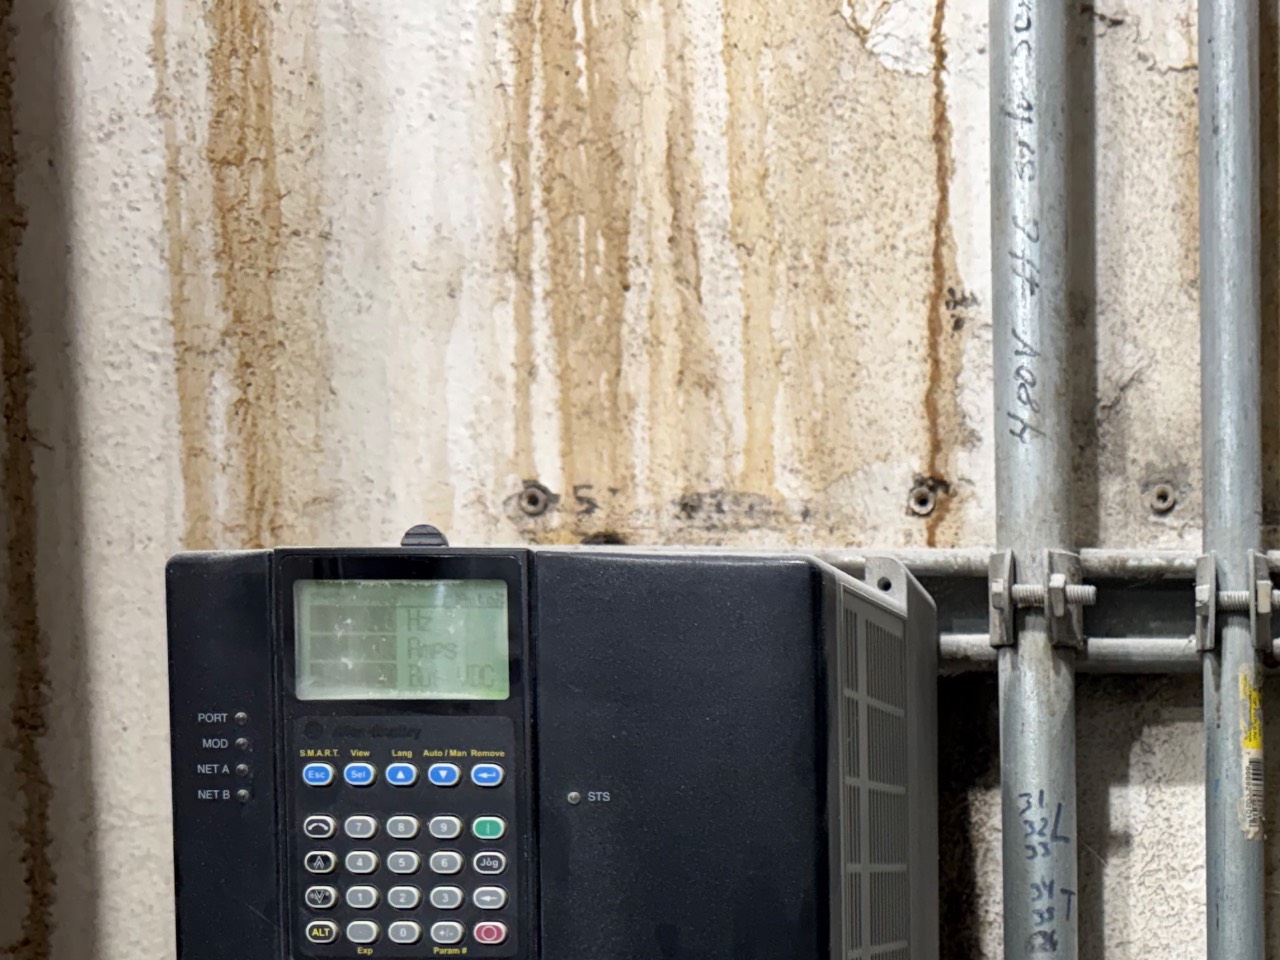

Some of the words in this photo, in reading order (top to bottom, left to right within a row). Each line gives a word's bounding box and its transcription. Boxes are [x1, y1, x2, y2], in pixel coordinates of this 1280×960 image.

[197, 712, 229, 723] PORT
[202, 738, 228, 749] MOD
[350, 748, 371, 757] View
[391, 749, 413, 758] Lang
[423, 749, 443, 757] Auto
[449, 749, 467, 757] Man
[470, 749, 505, 758] Remove
[197, 763, 219, 774] NET
[221, 764, 230, 774] A
[308, 770, 326, 779] Esc
[350, 769, 366, 779] Sel
[197, 789, 219, 800] NET
[222, 789, 231, 800] B
[587, 791, 611, 802] STS
[311, 927, 330, 937] ALT
[357, 946, 373, 955] Exp
[433, 946, 460, 955] Param
